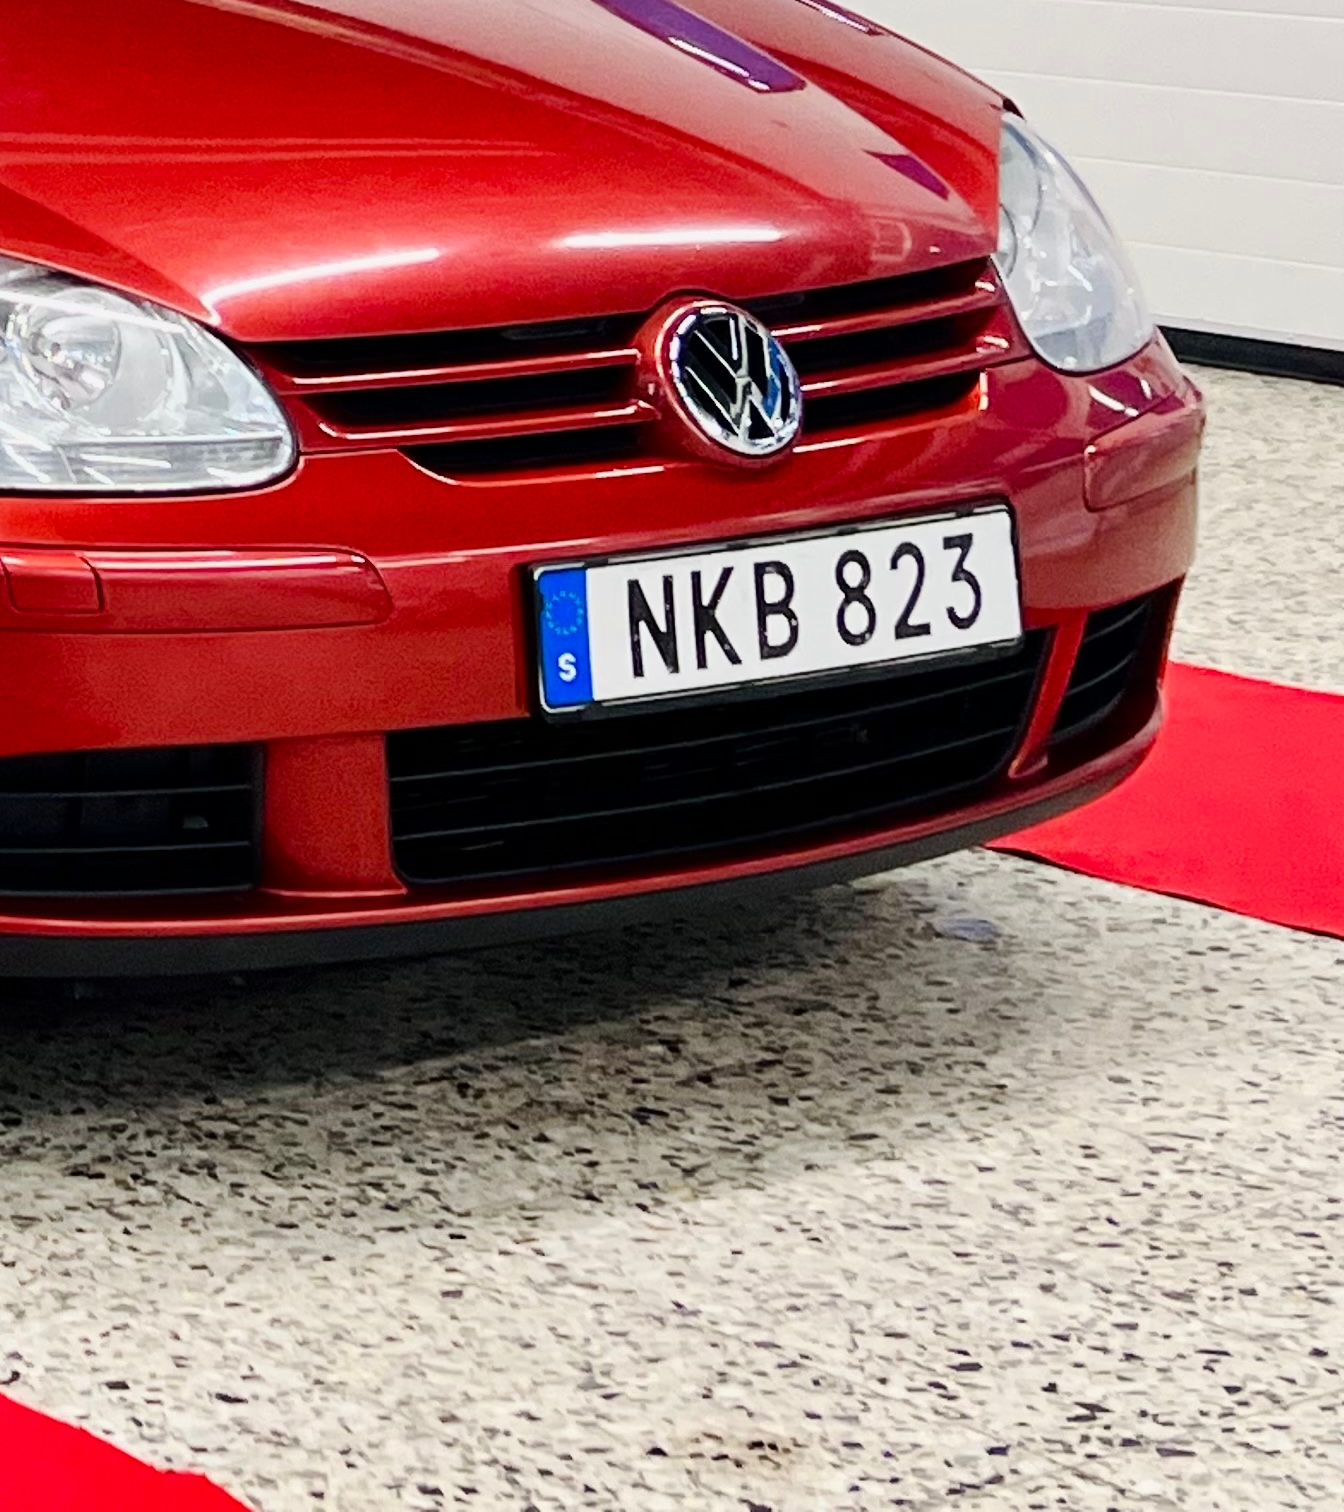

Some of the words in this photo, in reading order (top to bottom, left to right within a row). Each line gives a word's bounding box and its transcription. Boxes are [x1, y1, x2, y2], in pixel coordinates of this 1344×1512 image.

[625, 560, 800, 679] NKB
[834, 532, 982, 647] 823
[556, 651, 578, 684] S
